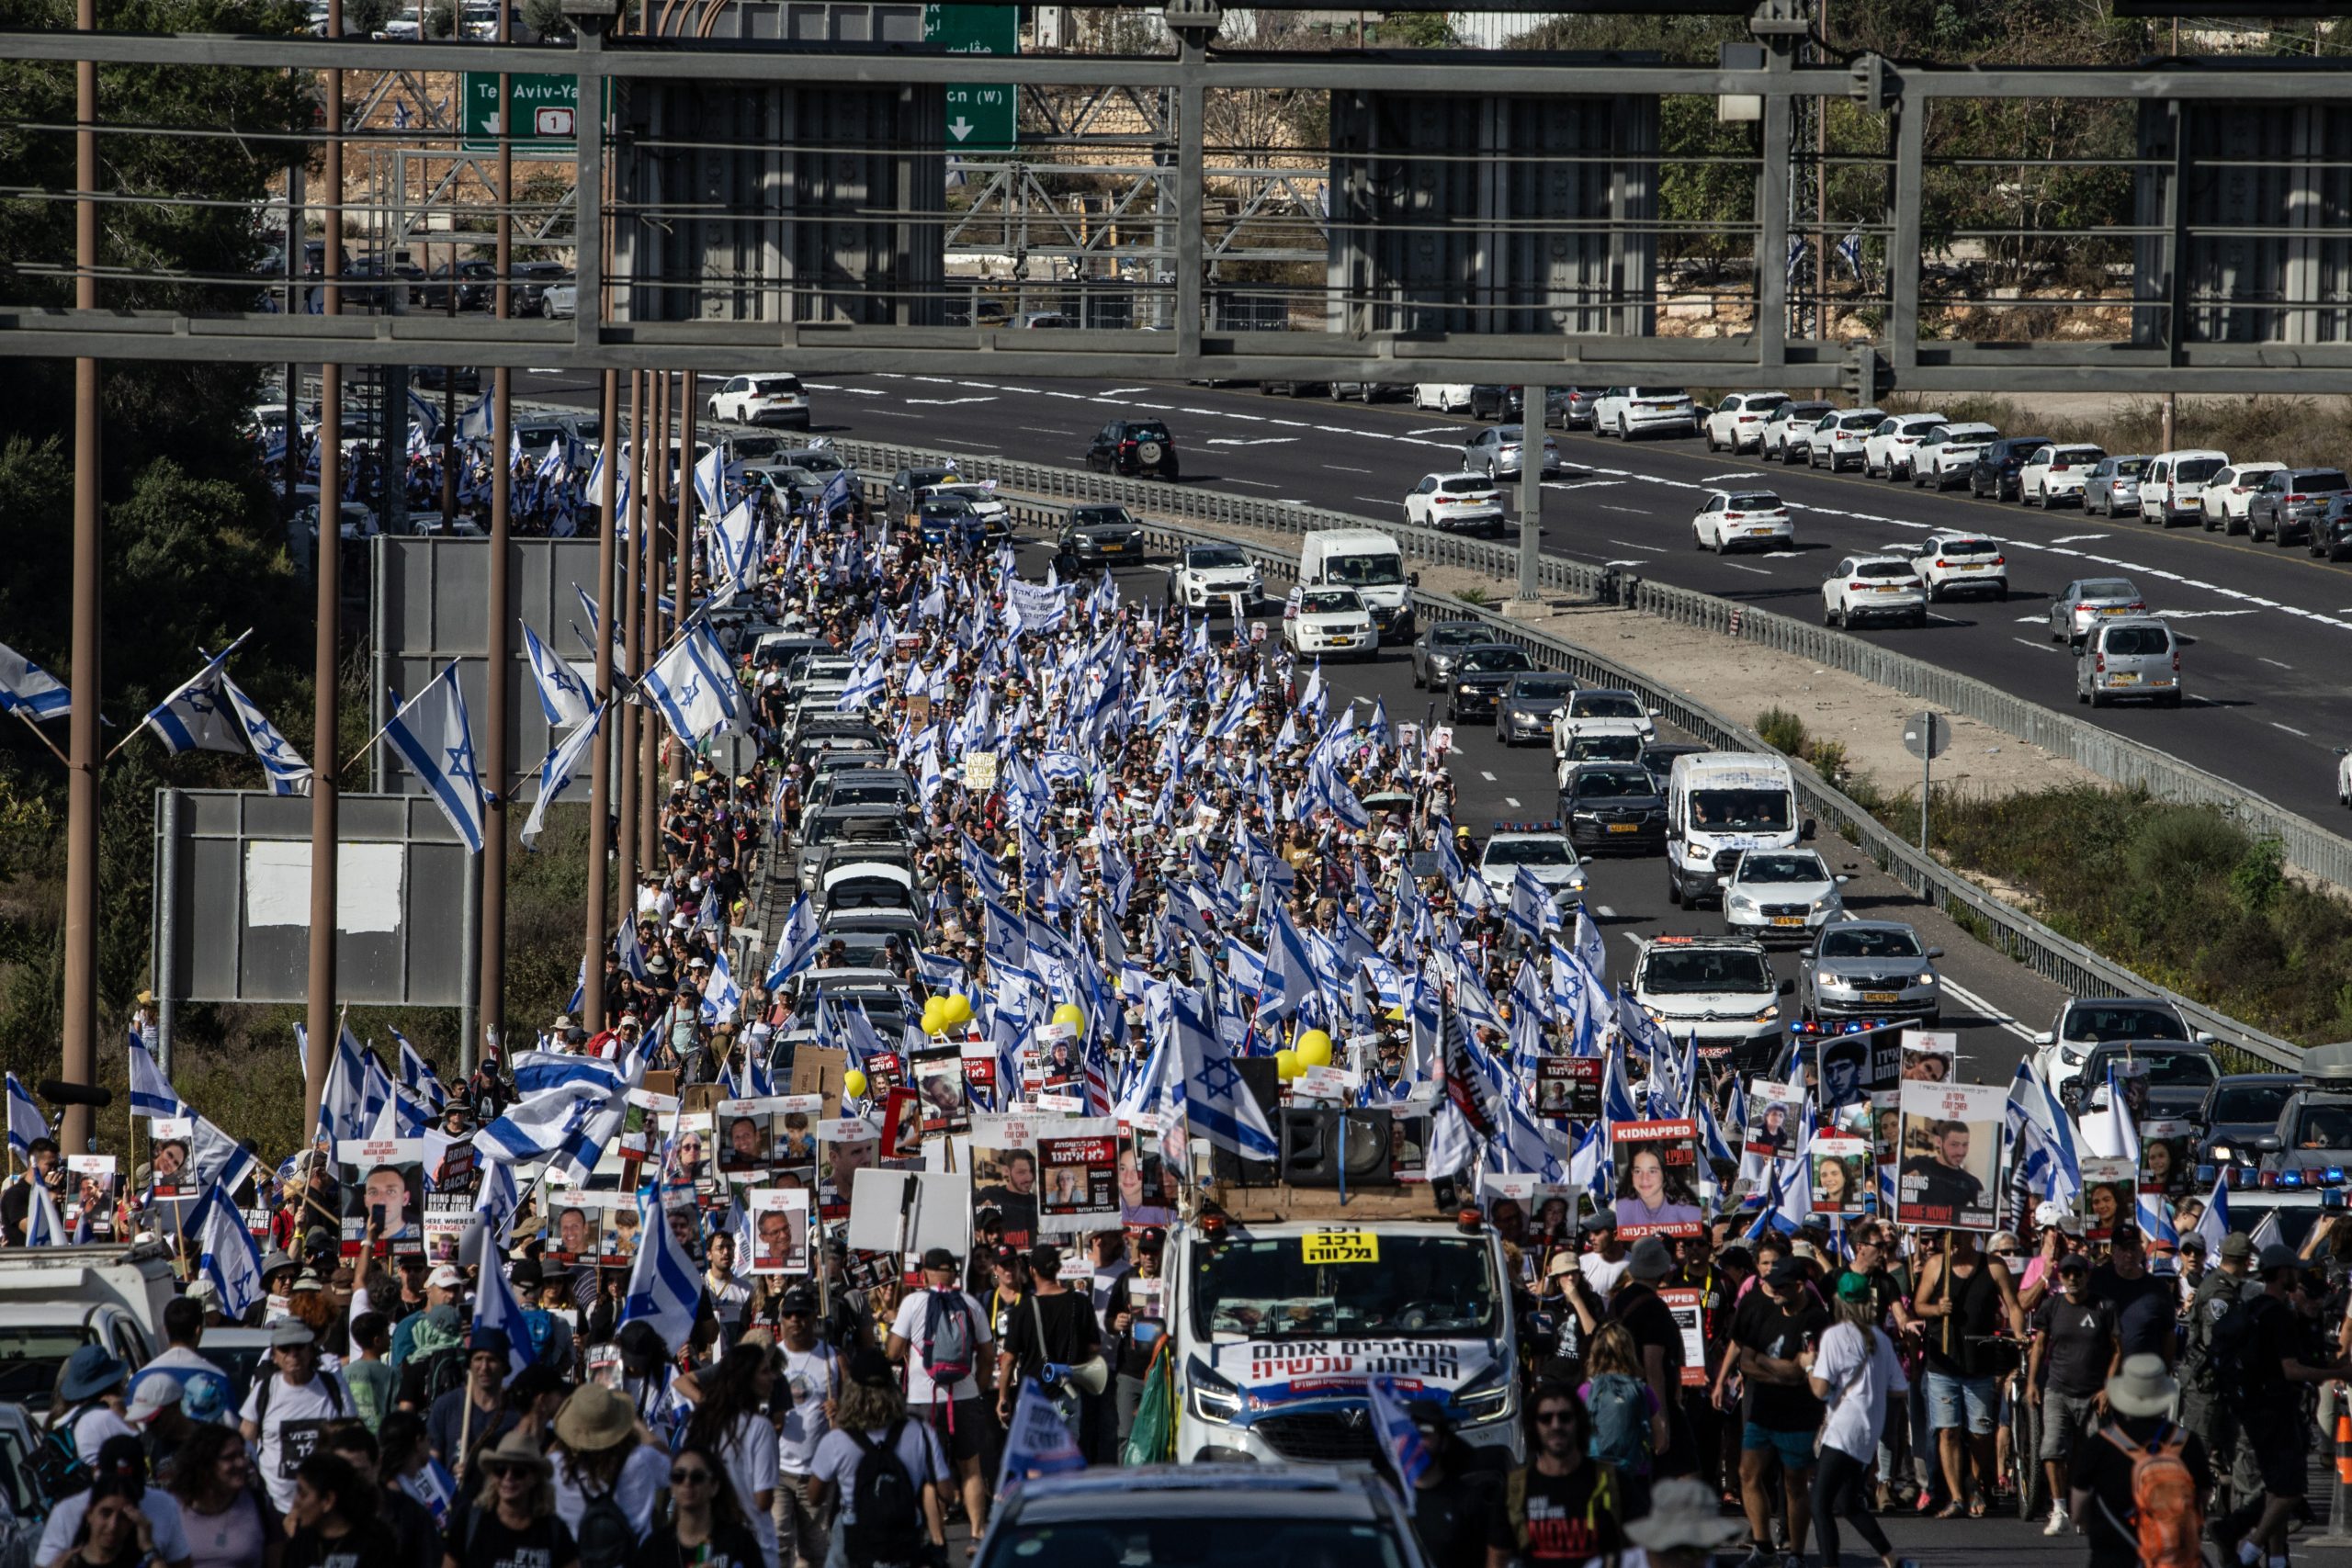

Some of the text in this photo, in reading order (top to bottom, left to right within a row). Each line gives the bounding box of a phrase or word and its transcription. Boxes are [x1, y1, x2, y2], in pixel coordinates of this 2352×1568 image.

[478, 84, 579, 98] Te Aviv-Ya
[977, 90, 1002, 105] (W)
[550, 116, 557, 129] 1
[1617, 1125, 1690, 1139] KIDNAPPED
[447, 1145, 474, 1158] BRING
[1051, 1150, 1105, 1162] לא איתנו
[444, 1173, 469, 1191] BACK!
[1902, 1175, 1928, 1190] BRING
[428, 1193, 471, 1203] BRING OMER
[820, 1196, 831, 1205] HIM
[1901, 1189, 1918, 1203] HIM
[449, 1203, 471, 1212] HOME
[1899, 1204, 1952, 1221] HOME NOW!
[249, 1210, 270, 1220] OMER
[247, 1219, 268, 1228] HOME
[341, 1216, 365, 1229] BRING
[341, 1229, 356, 1241] HIM
[1623, 1223, 1698, 1236] גלי חטופה בעזה
[1317, 1235, 1362, 1246] רכב
[1309, 1247, 1372, 1260] מלווה
[1661, 1293, 1696, 1303] APPED
[1252, 1340, 1459, 1359] מחזירים אותם
[1251, 1357, 1459, 1380] הביתה עכשיו!
